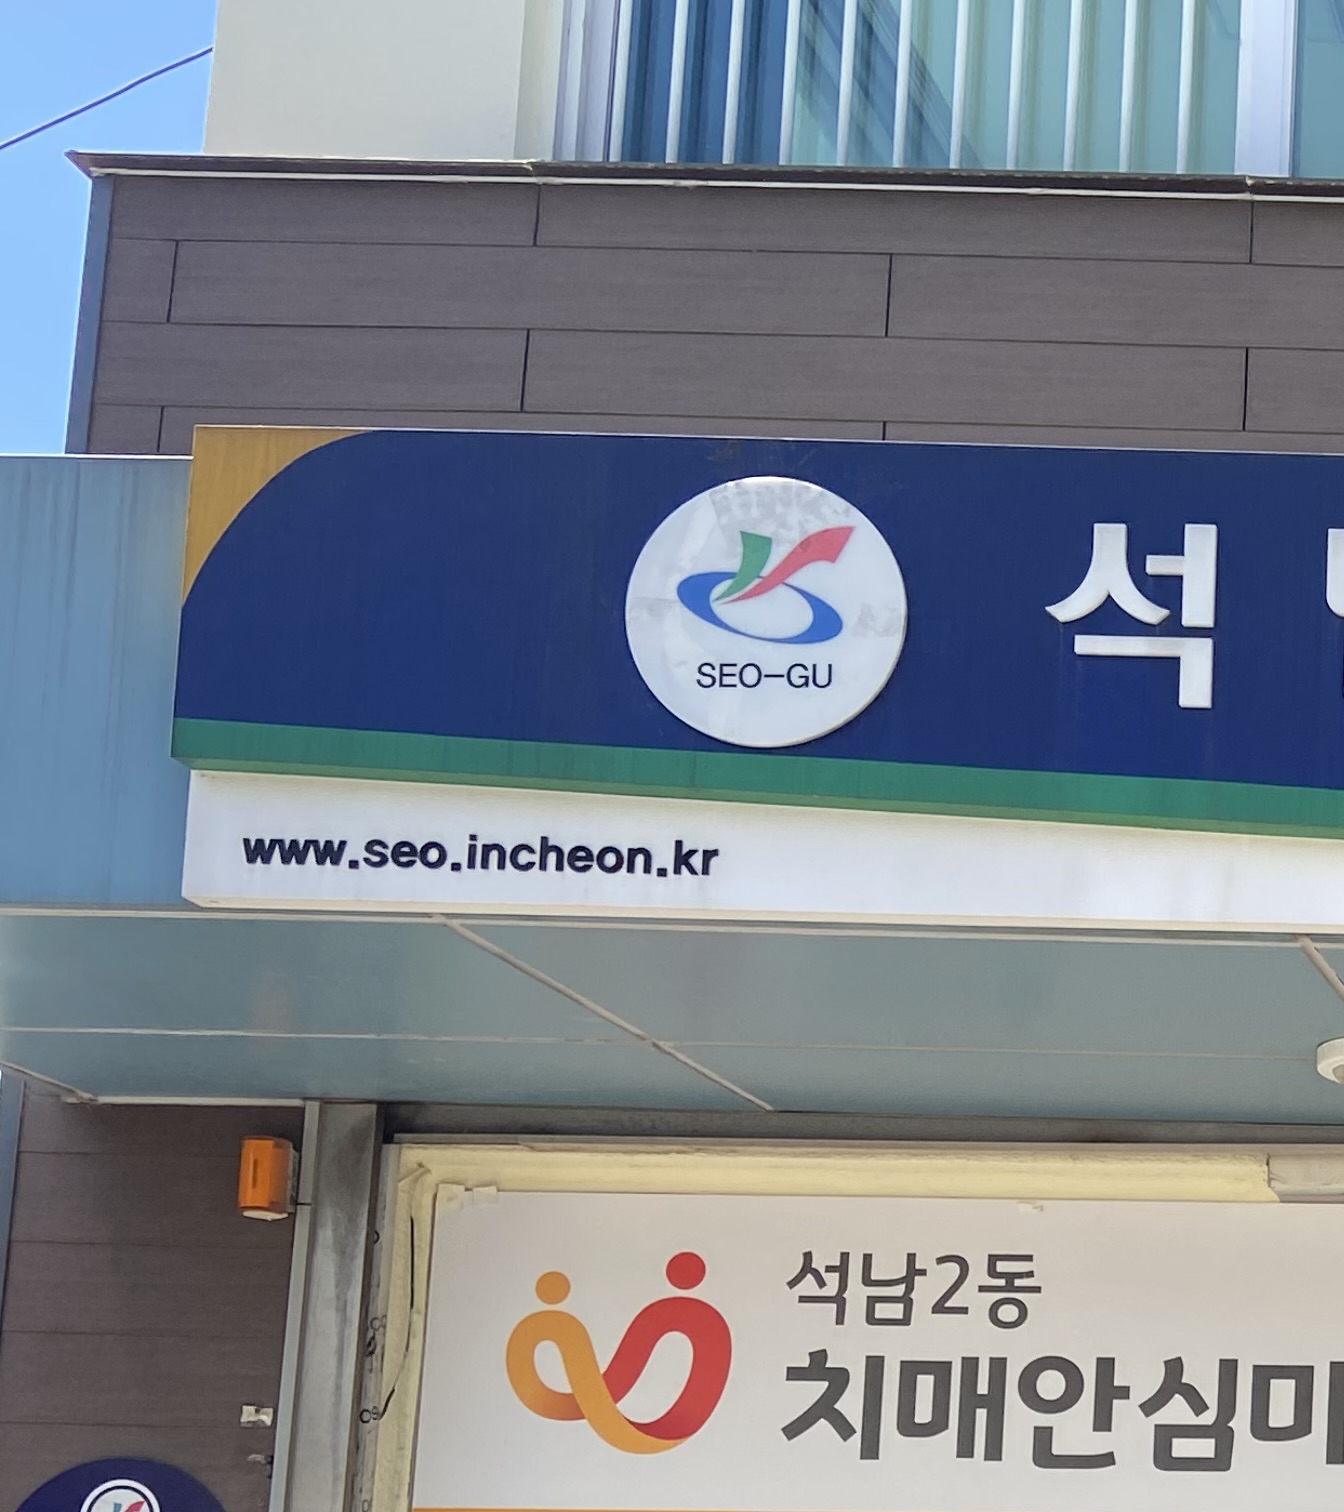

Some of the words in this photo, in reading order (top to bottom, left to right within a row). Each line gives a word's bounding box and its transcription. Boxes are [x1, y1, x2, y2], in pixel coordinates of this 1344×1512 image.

[697, 663, 832, 689] SEO-GU
[243, 834, 719, 878] www.seo.incheon.kr
[786, 1250, 1042, 1330] 석남2동
